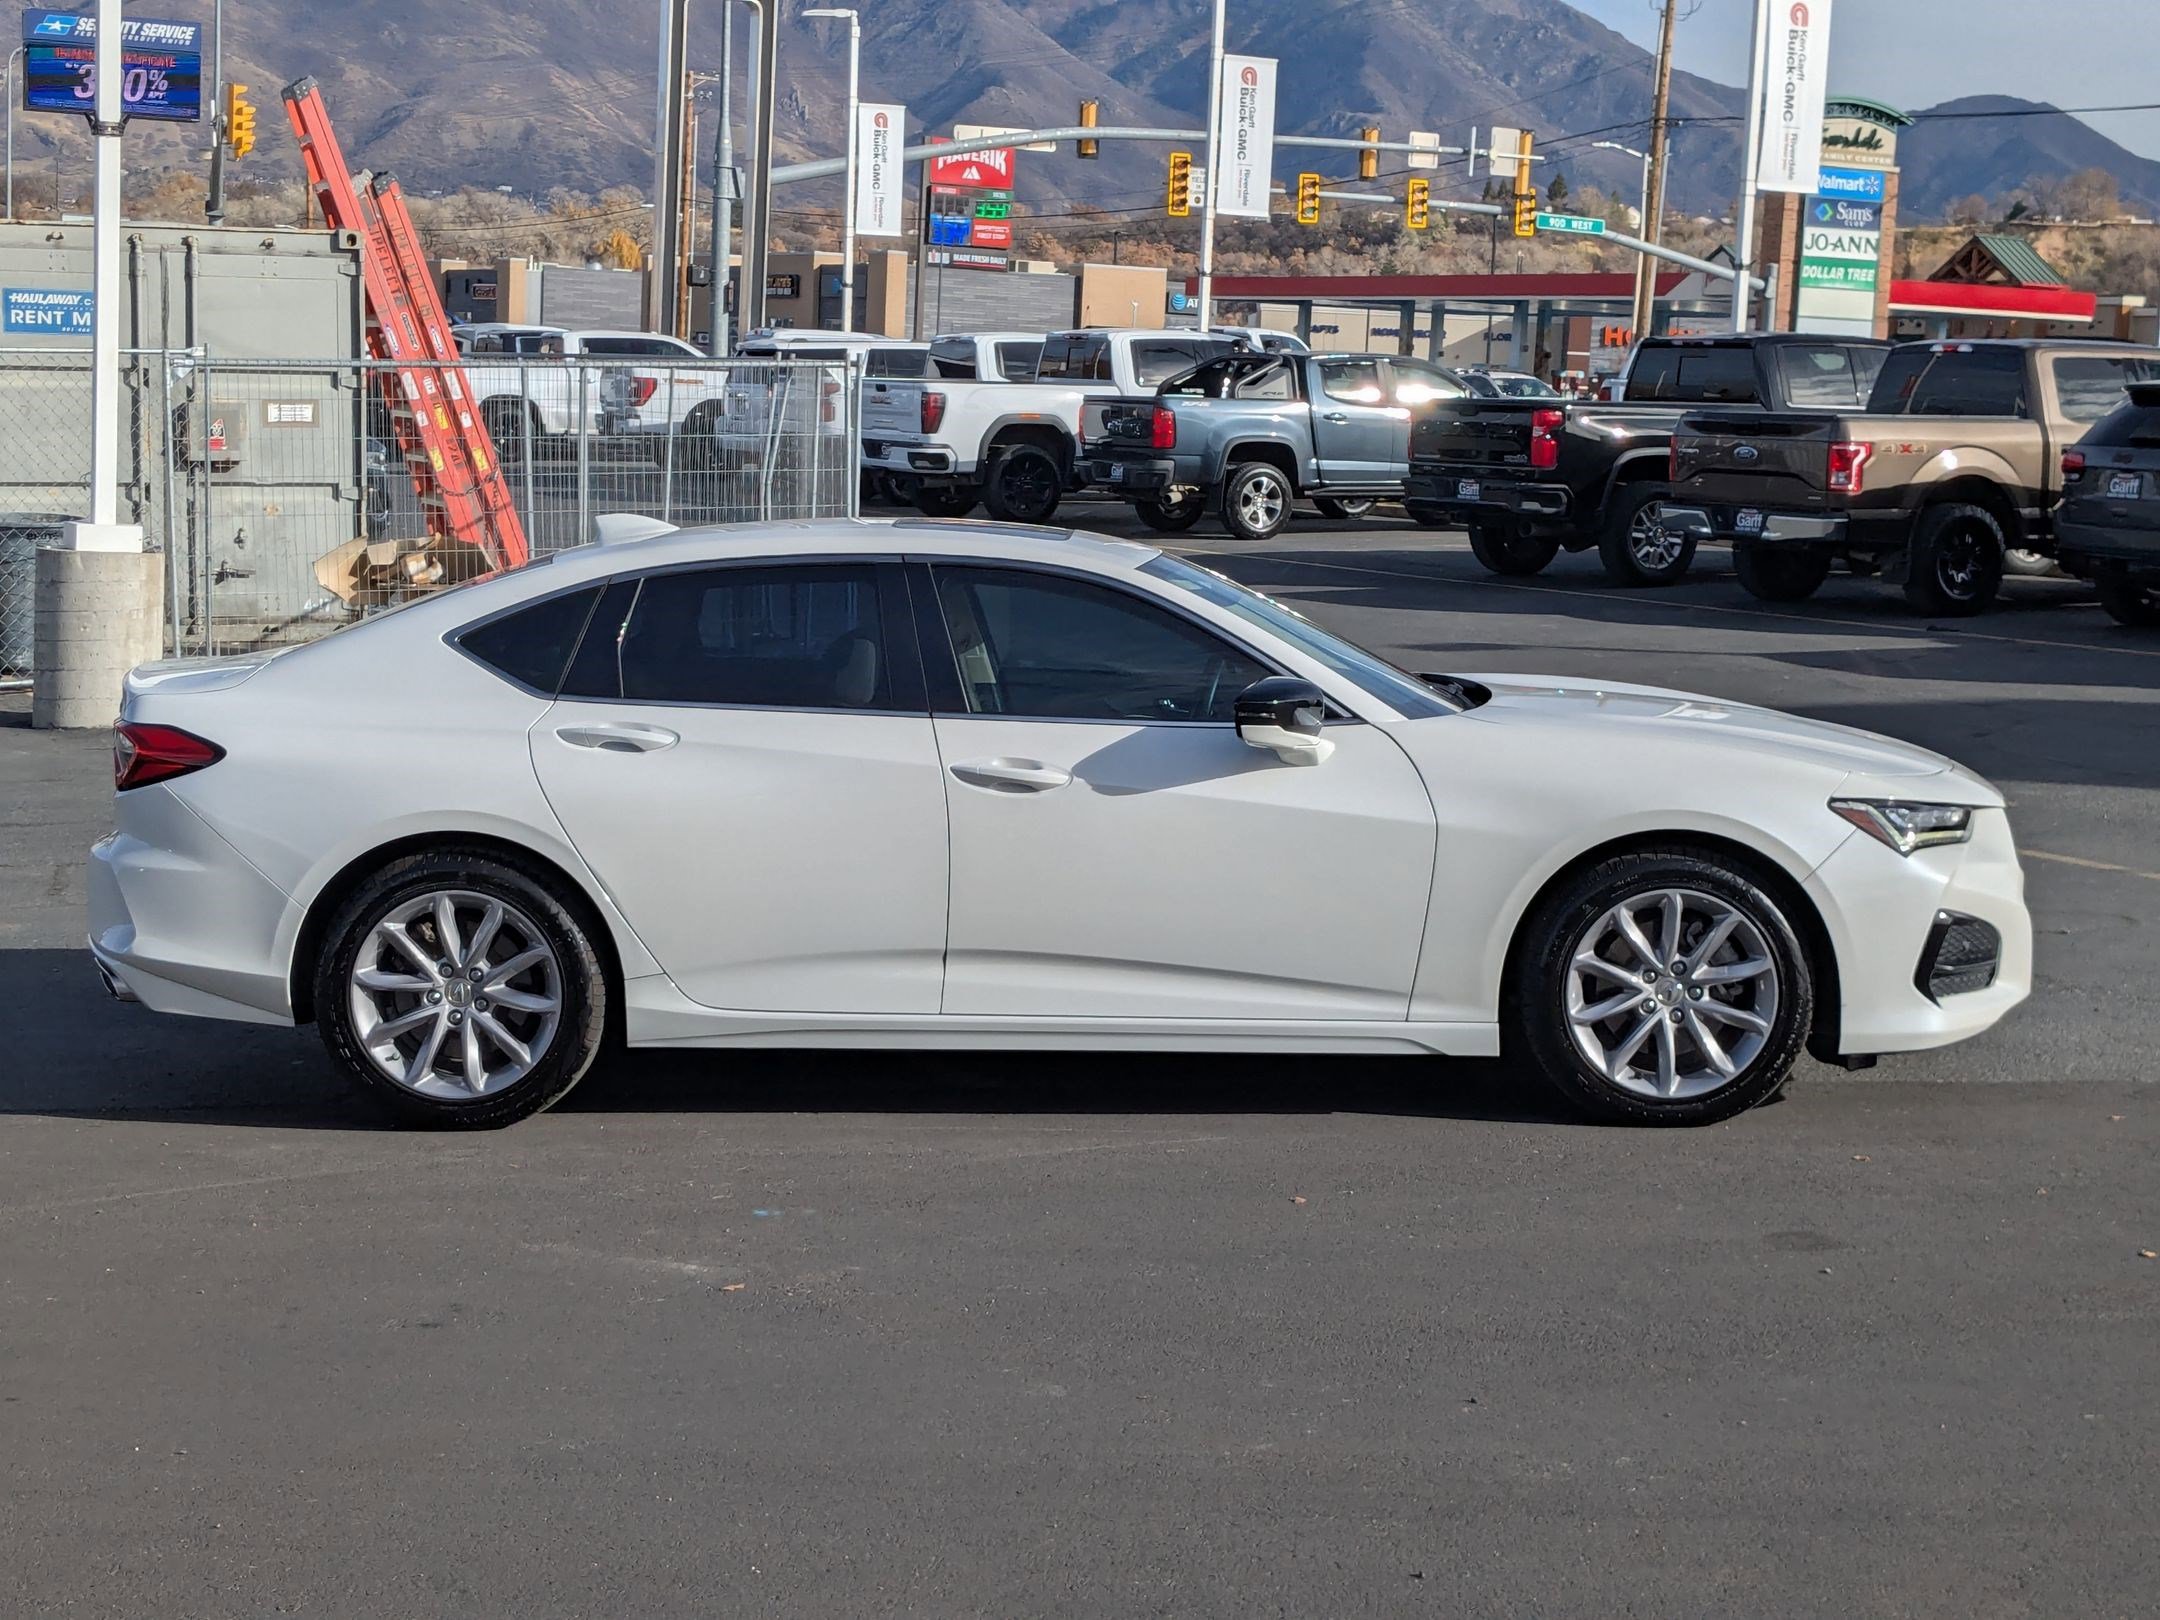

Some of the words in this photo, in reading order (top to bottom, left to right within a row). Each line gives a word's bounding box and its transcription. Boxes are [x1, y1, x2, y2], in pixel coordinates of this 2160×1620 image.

[141, 22, 195, 40] SERVICE
[937, 149, 1008, 177] MAVERIK
[1787, 133, 1798, 180] Riverdale
[1549, 217, 1567, 228] 900
[1571, 220, 1594, 231] WEST
[1801, 264, 1845, 280] DOLLAR
[1847, 267, 1875, 282] TREE
[10, 309, 65, 325] RENT
[72, 312, 92, 326] M
[1736, 512, 1763, 528] Garff
